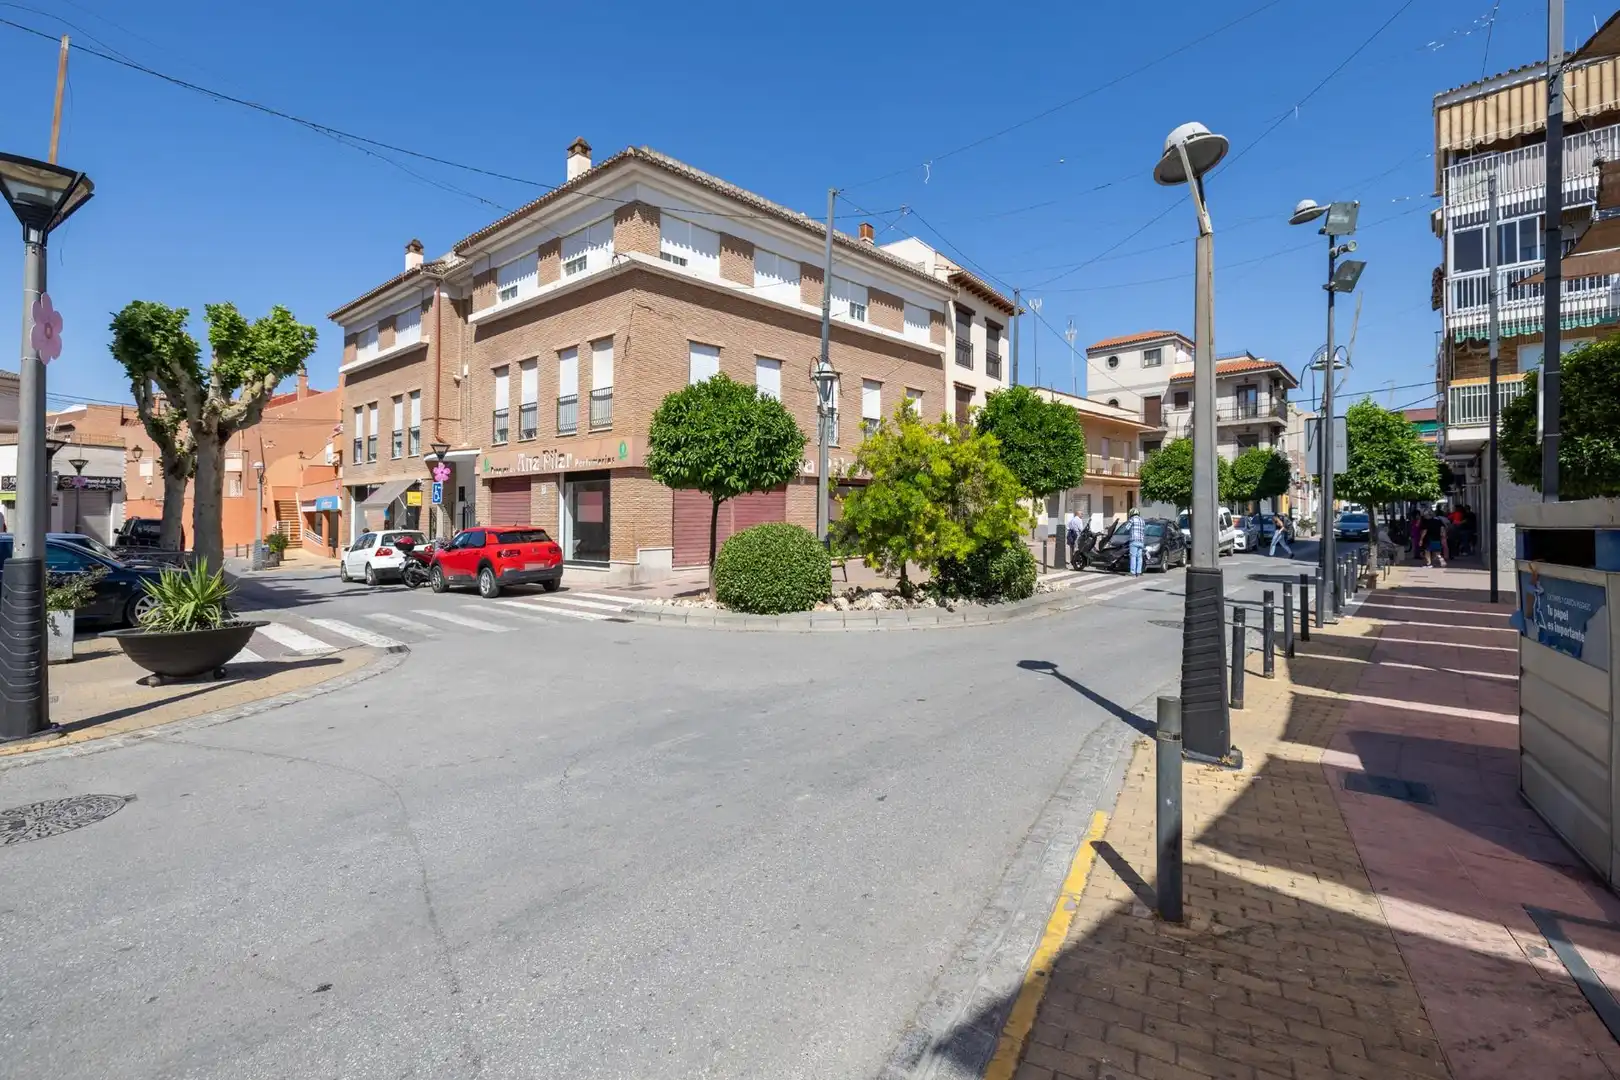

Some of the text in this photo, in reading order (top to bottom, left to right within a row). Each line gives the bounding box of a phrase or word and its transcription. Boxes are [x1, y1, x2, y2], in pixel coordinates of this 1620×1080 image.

[517, 453, 540, 472] Ana
[542, 448, 572, 471] Pilar
[1547, 604, 1568, 622] Tu papel
[1547, 621, 1584, 642] es importante
